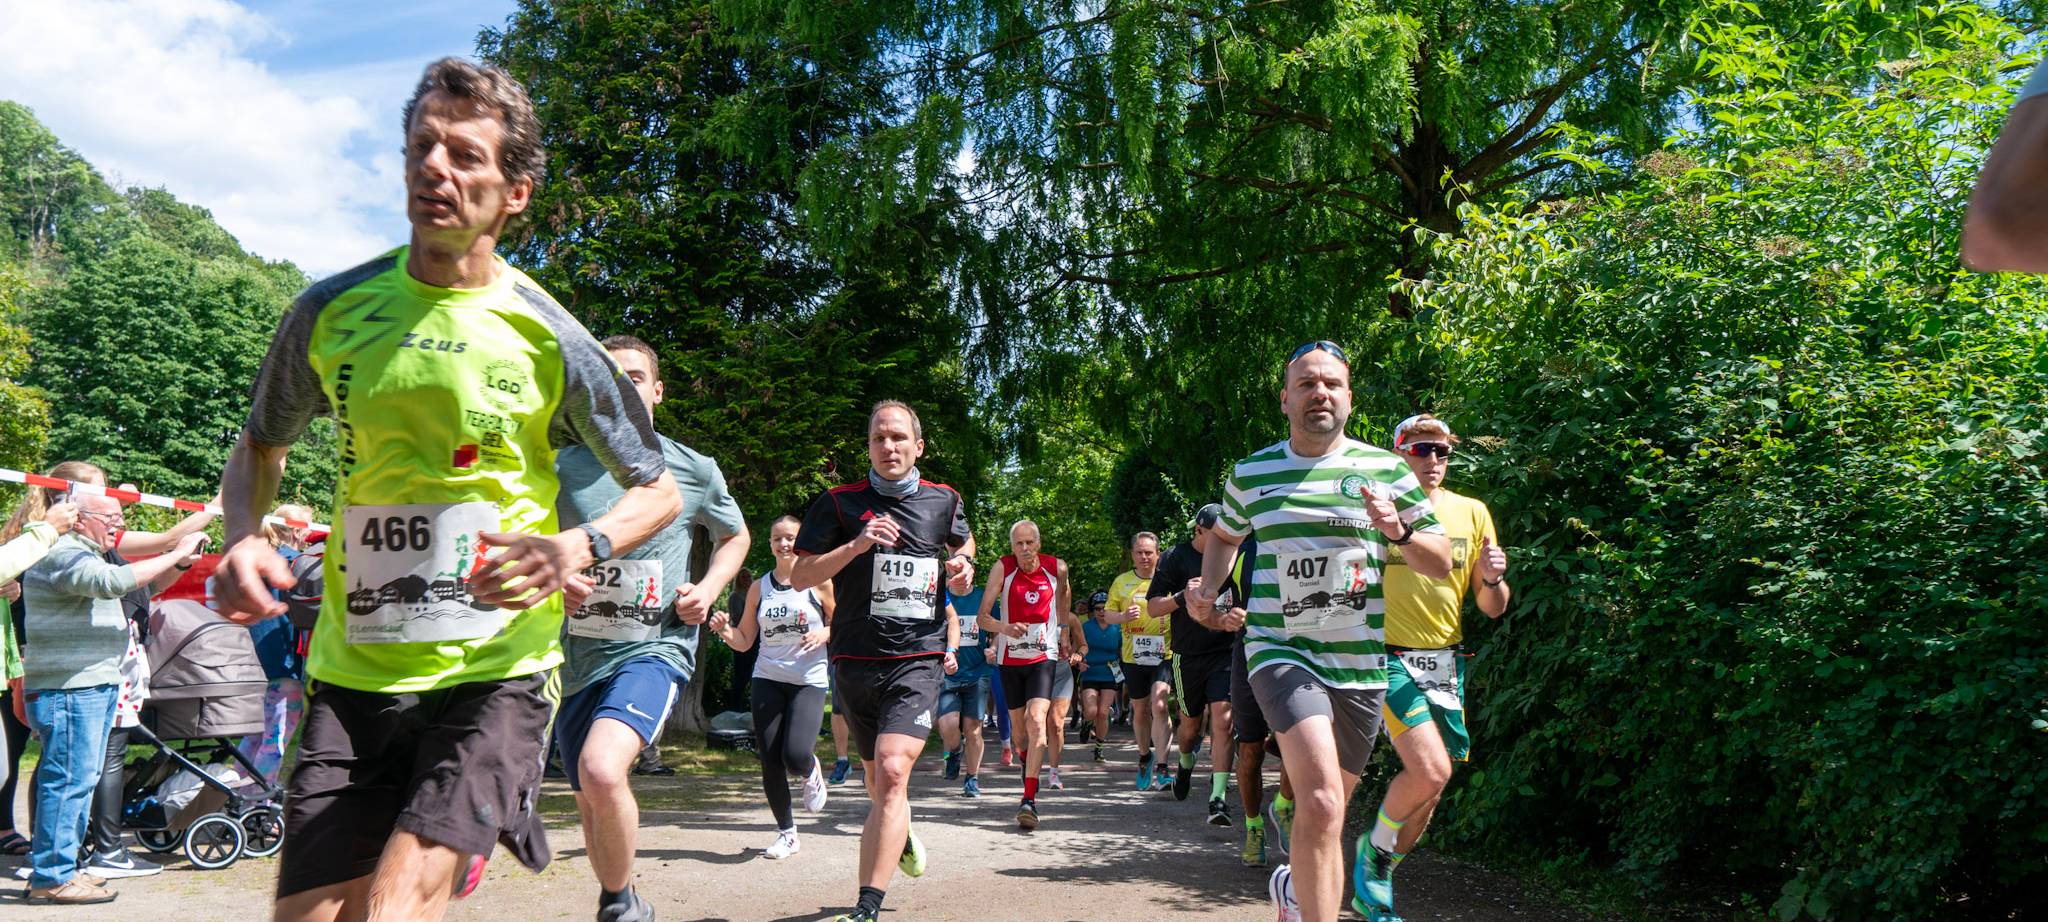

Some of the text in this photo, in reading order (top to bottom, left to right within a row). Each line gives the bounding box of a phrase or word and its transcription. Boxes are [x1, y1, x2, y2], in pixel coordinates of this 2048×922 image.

[398, 332, 467, 353] Zeus
[486, 375, 521, 395] LGD
[361, 515, 431, 553] 466
[880, 560, 915, 577] 419
[1286, 556, 1328, 580] 407
[765, 606, 788, 619] 439
[1135, 638, 1152, 646] 445
